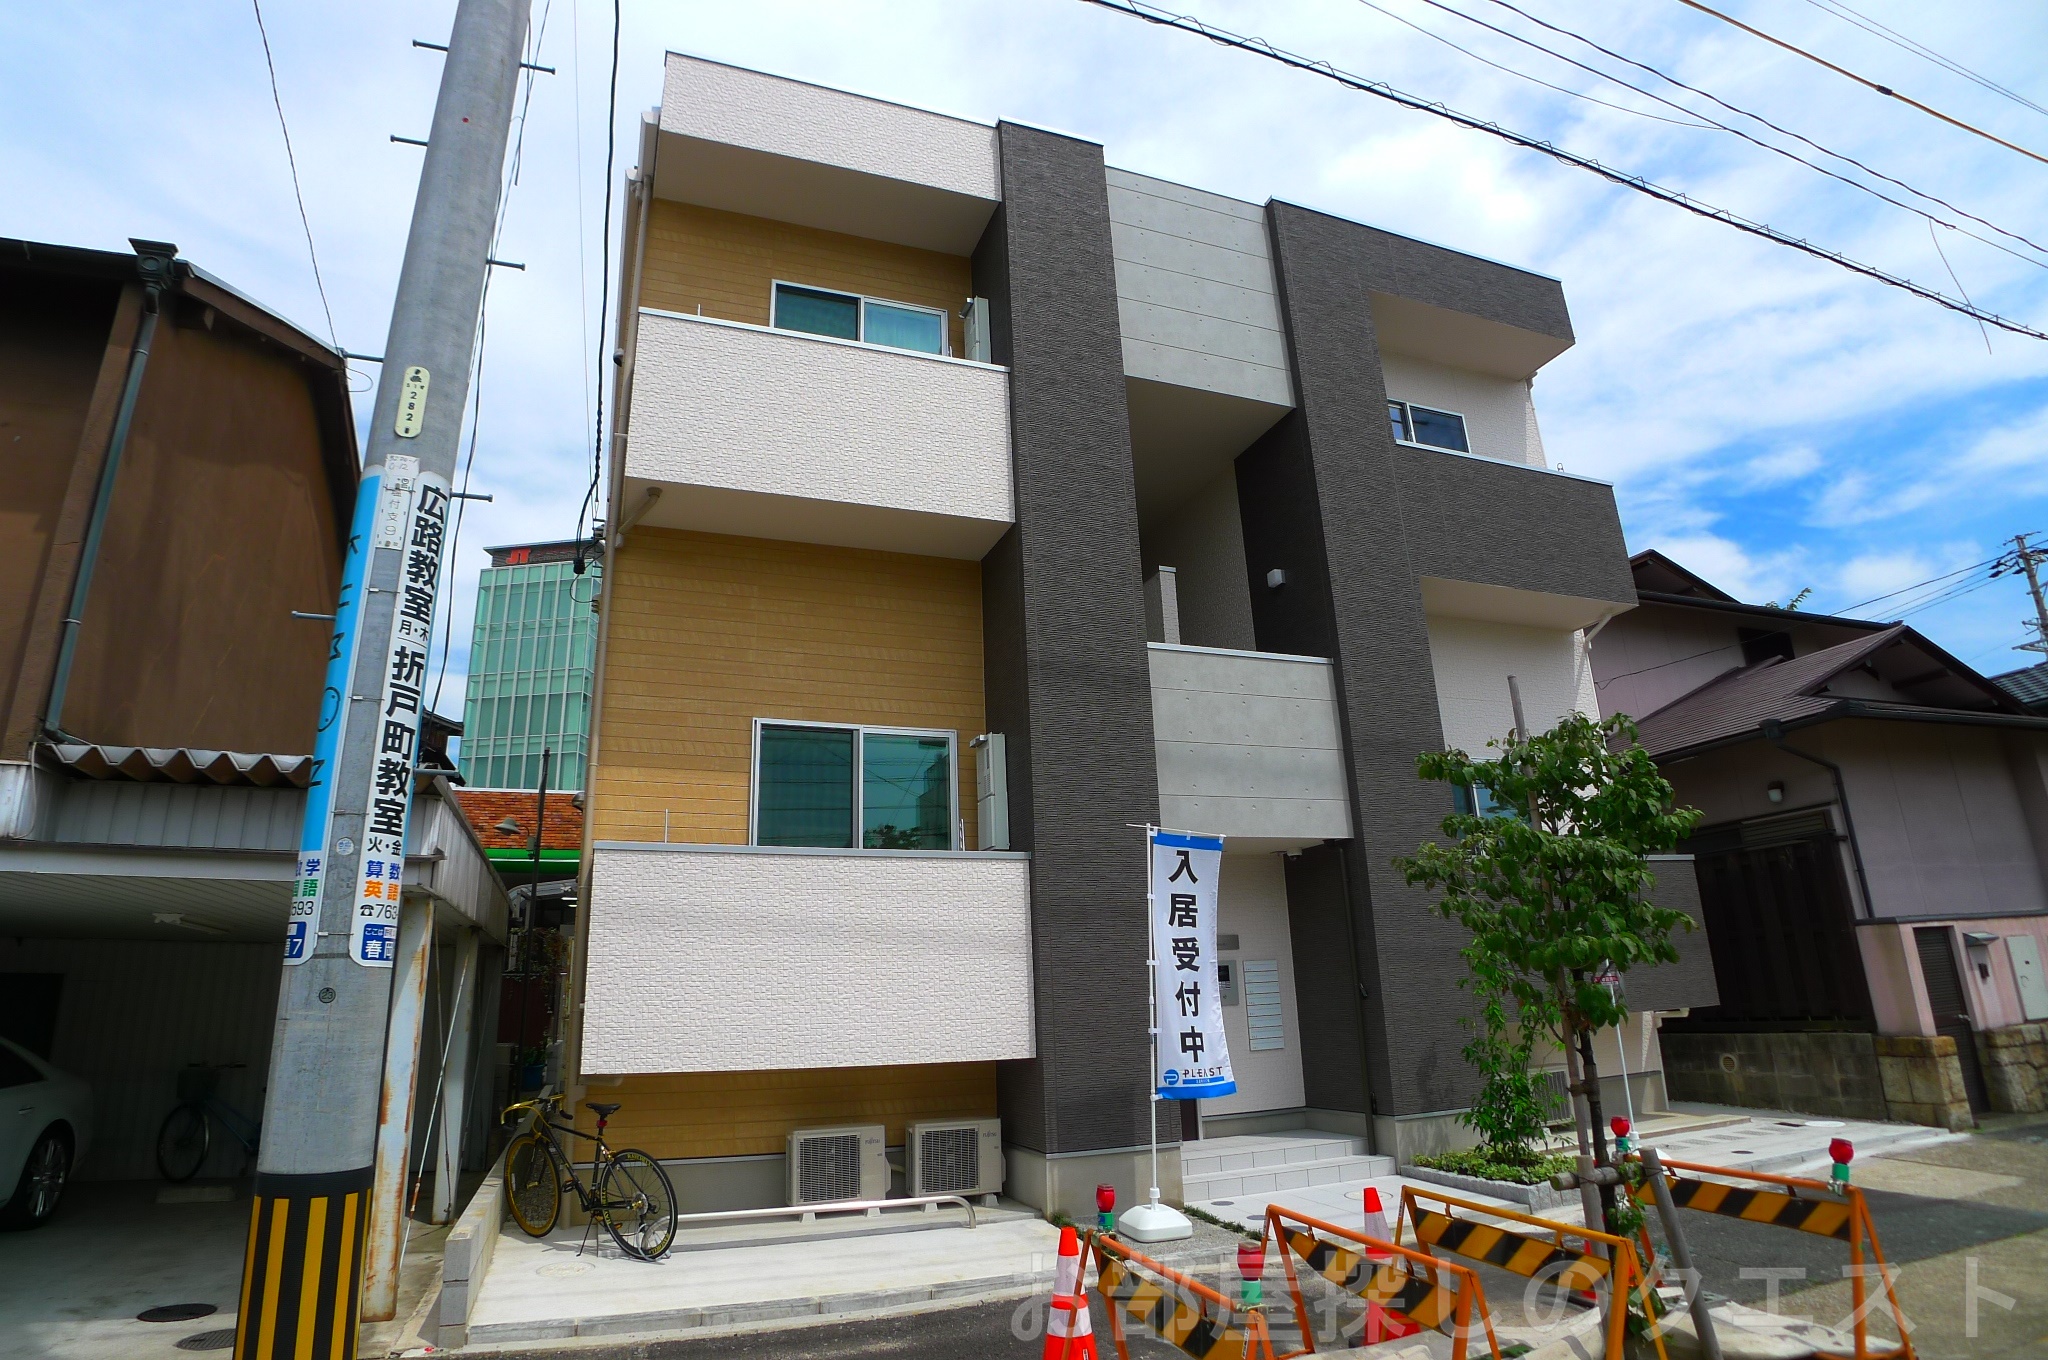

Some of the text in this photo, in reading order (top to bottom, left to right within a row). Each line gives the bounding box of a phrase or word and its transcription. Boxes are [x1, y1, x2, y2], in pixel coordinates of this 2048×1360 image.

[401, 484, 448, 626] 広路教室
[369, 645, 426, 838] 折戸町教室
[363, 880, 400, 902] 英語
[365, 860, 401, 881] 算数
[1168, 850, 1205, 1063] 入居受付中
